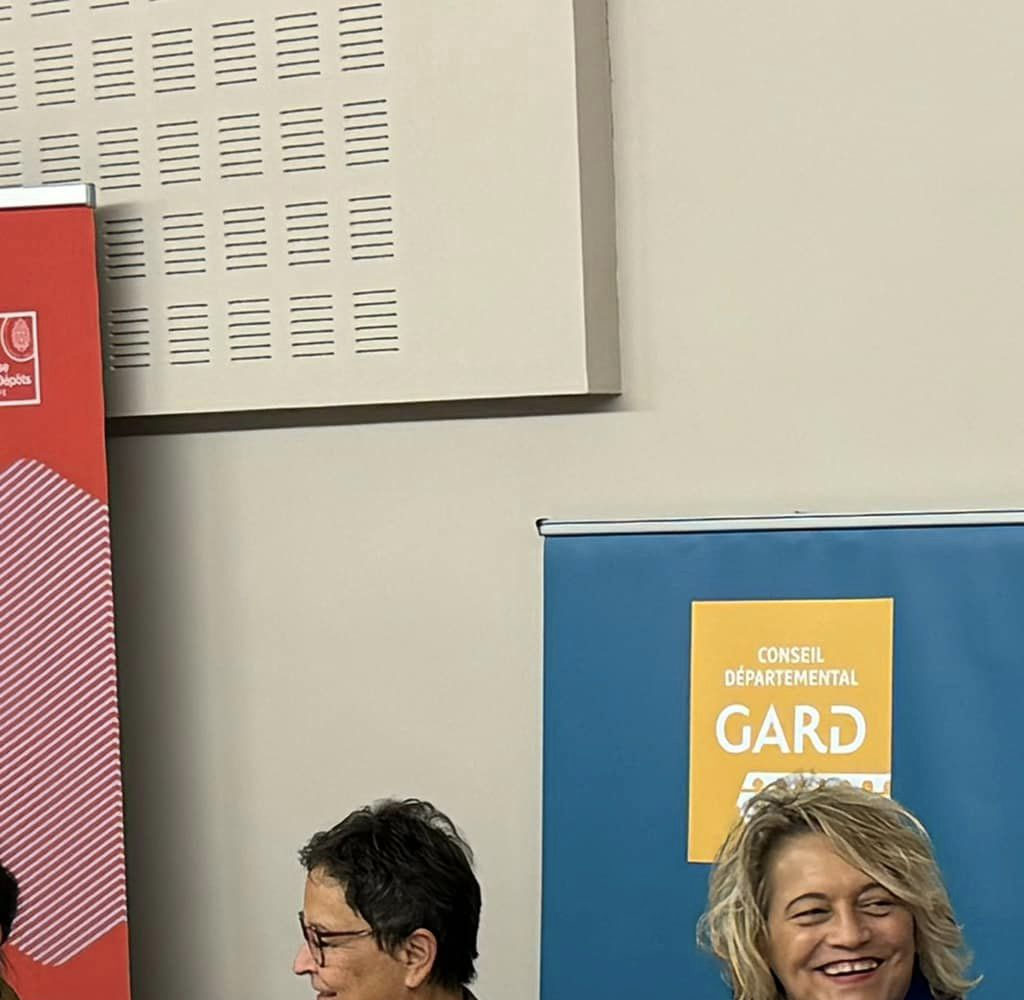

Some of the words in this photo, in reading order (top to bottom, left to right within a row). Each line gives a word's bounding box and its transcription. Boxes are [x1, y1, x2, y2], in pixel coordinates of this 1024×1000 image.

[757, 646, 824, 664] CONSEIL
[724, 665, 859, 687] DÉPARTEMENTAL
[715, 703, 867, 754] GARD
